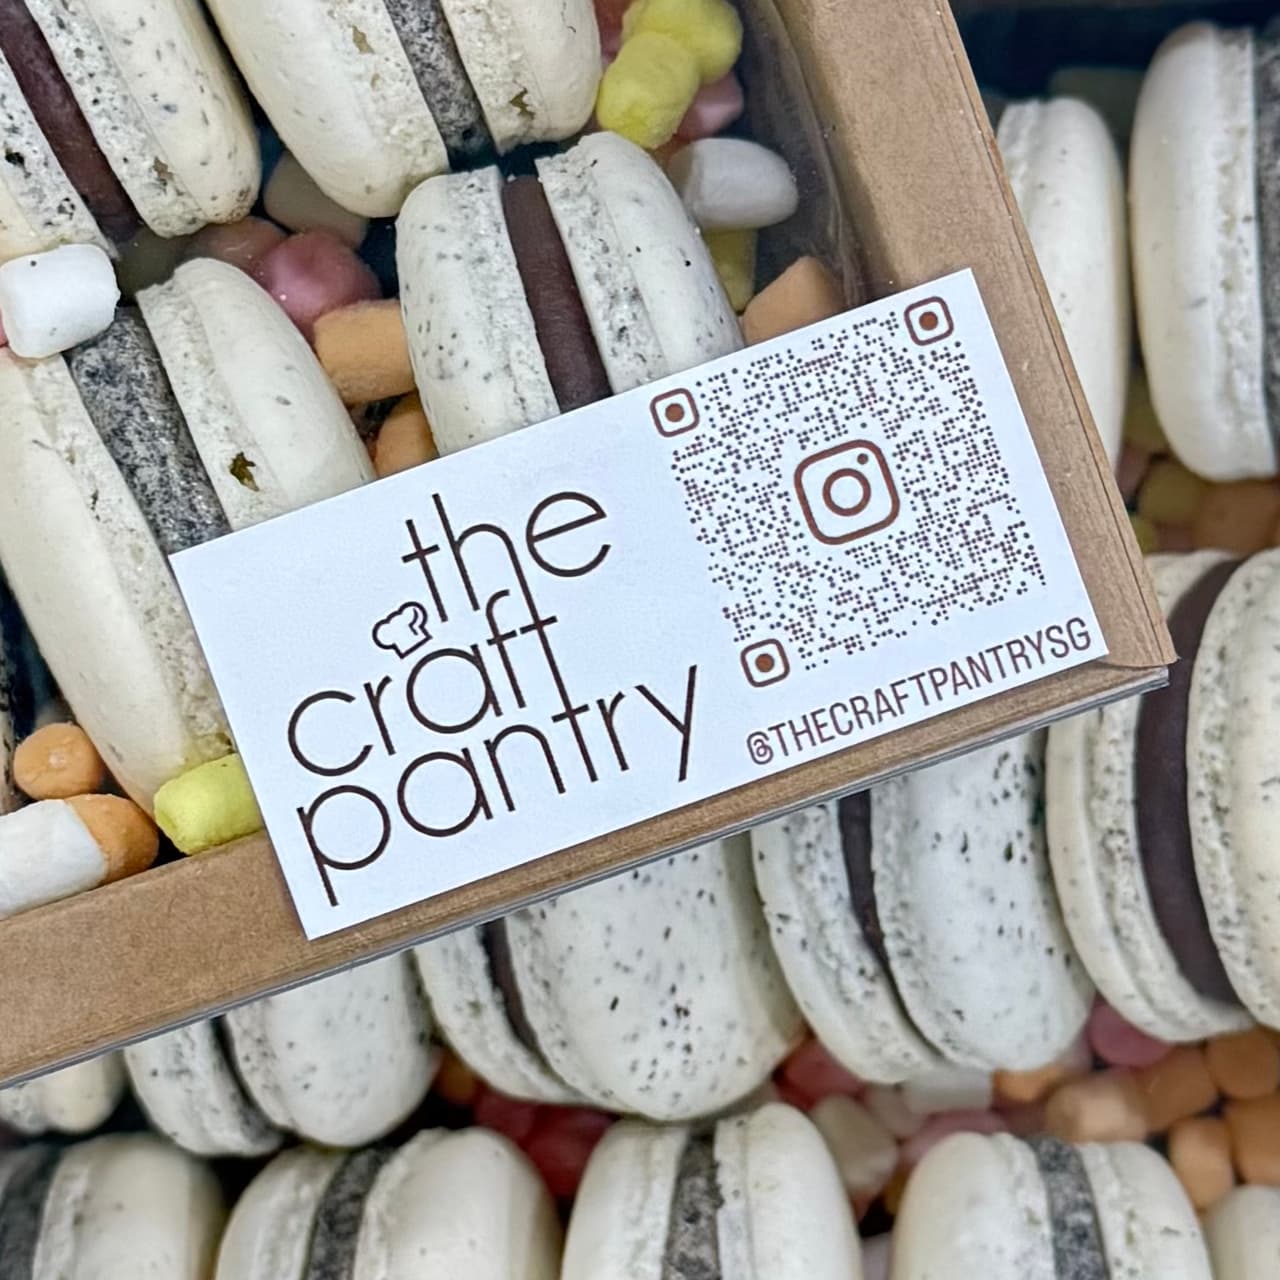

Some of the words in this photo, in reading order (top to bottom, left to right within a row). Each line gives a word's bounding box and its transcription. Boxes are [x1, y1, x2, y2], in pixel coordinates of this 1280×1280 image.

[401, 489, 609, 623] the
[287, 589, 558, 777] craft
[745, 616, 1093, 766] @THECRAFTPANTRYSG
[296, 664, 698, 908] pantry
